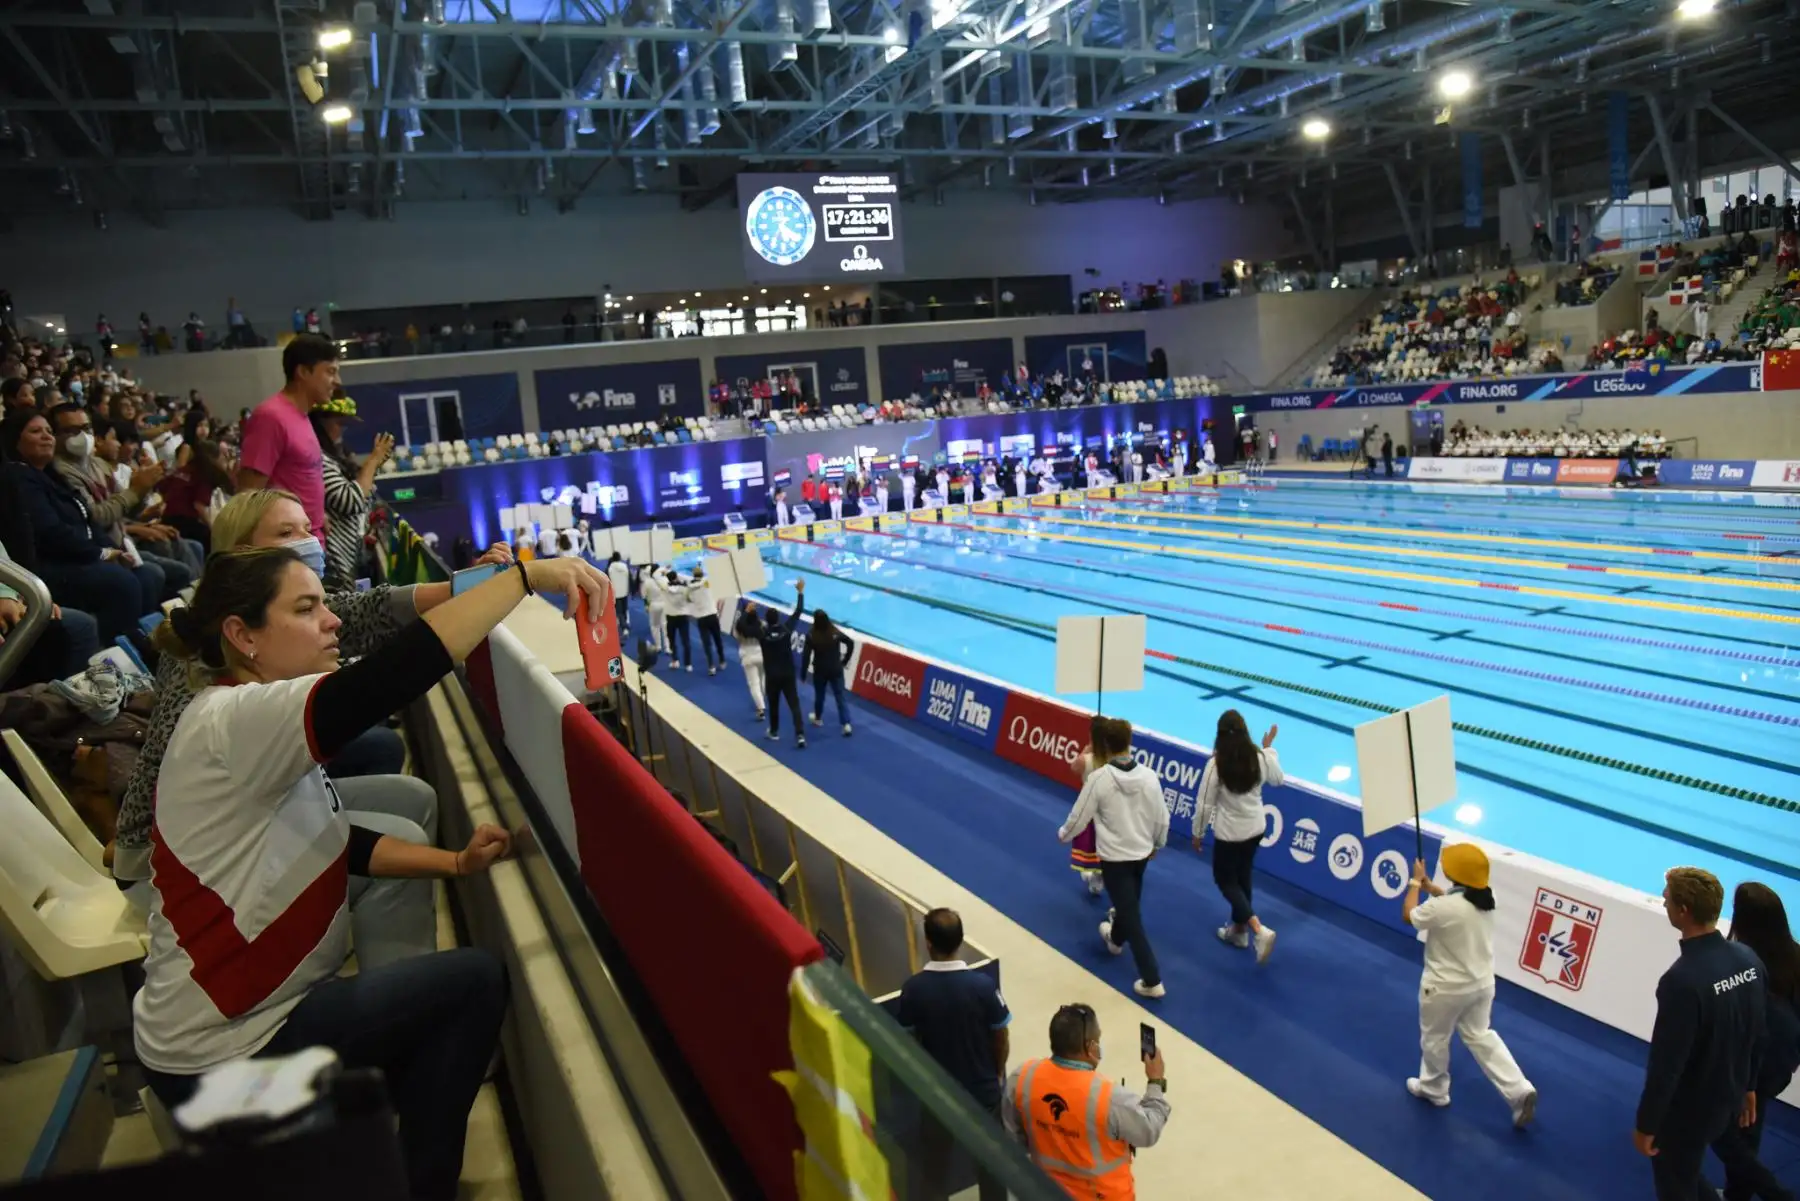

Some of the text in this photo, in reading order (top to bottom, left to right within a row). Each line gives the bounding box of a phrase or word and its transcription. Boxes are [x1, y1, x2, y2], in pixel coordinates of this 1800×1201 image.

[827, 209, 889, 225] 17:21:36
[1370, 392, 1404, 404] OMEGA
[1460, 383, 1518, 399] FINA.ORG
[873, 667, 912, 698] OMEGA
[929, 678, 956, 703] LIMA
[927, 697, 953, 722] 2022
[1029, 726, 1079, 764] OMEG
[1713, 967, 1758, 995] FRANCE
